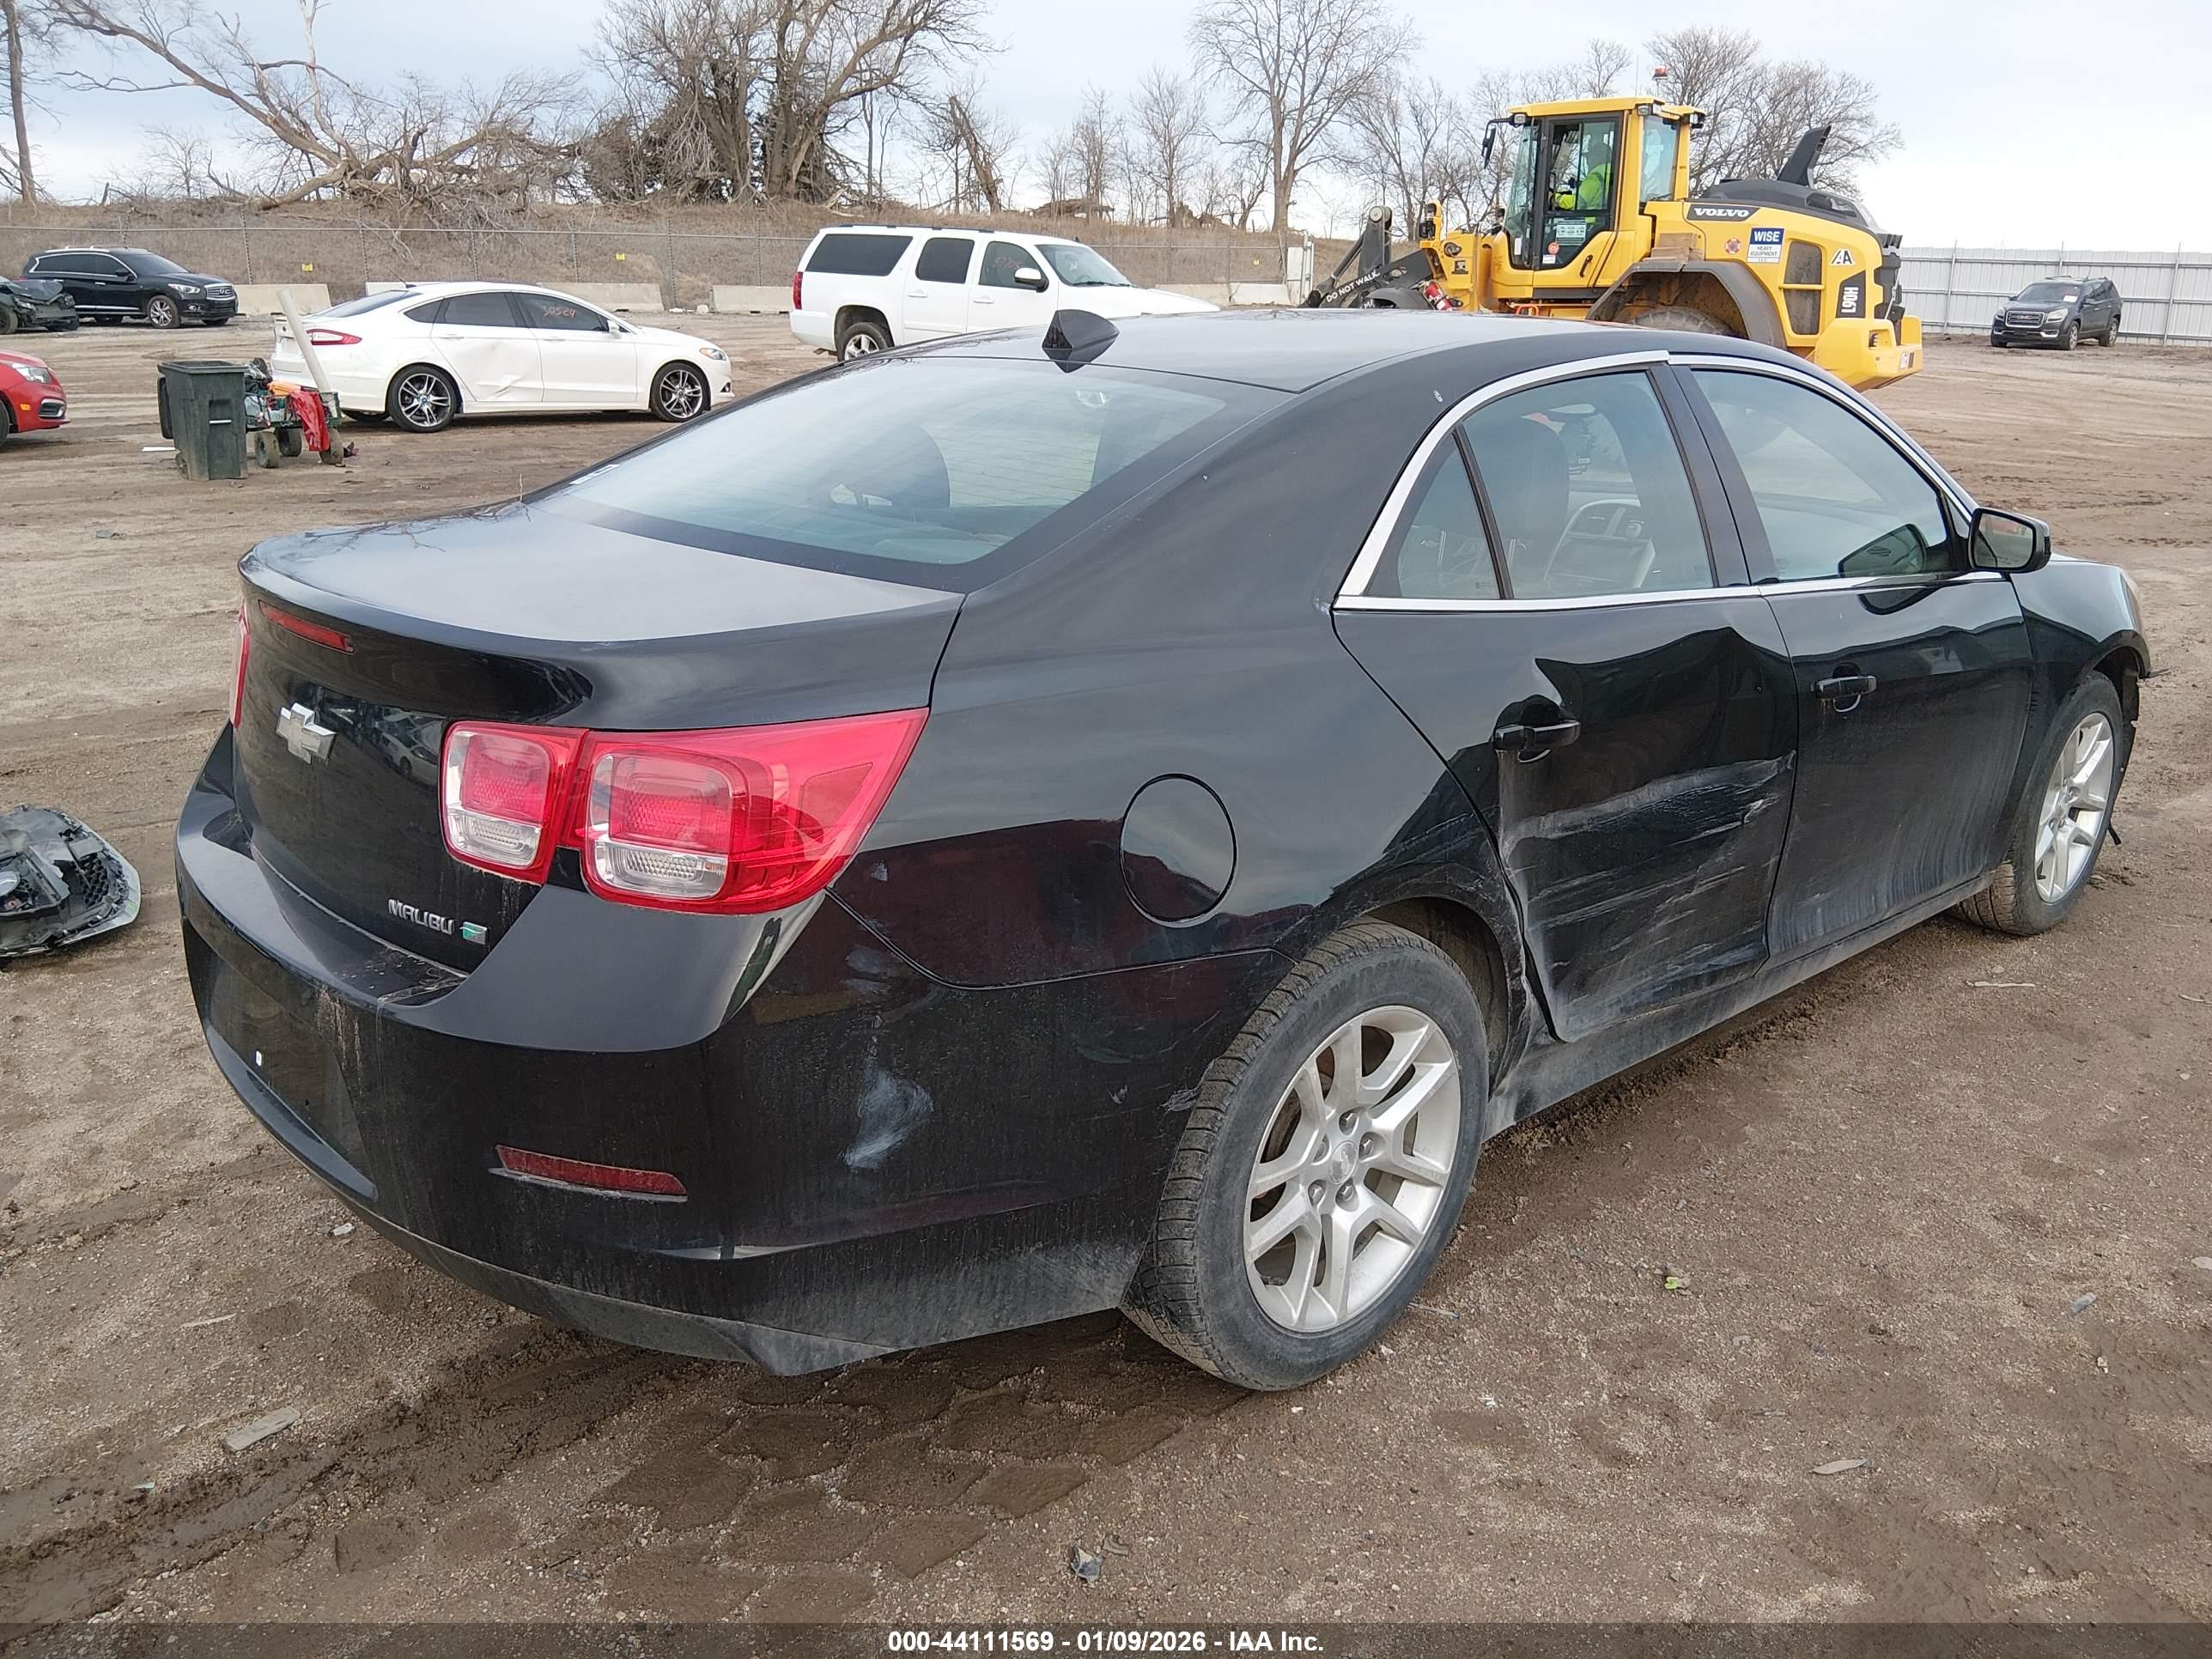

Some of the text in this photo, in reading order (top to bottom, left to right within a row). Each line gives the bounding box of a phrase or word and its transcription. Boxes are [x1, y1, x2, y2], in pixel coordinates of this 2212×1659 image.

[1693, 207, 1750, 217] VOLVO
[1753, 230, 1781, 242] WISE
[1326, 269, 1382, 303] DO NOT WALK
[1840, 287, 1860, 313] L90H
[388, 898, 455, 935] MALIBU
